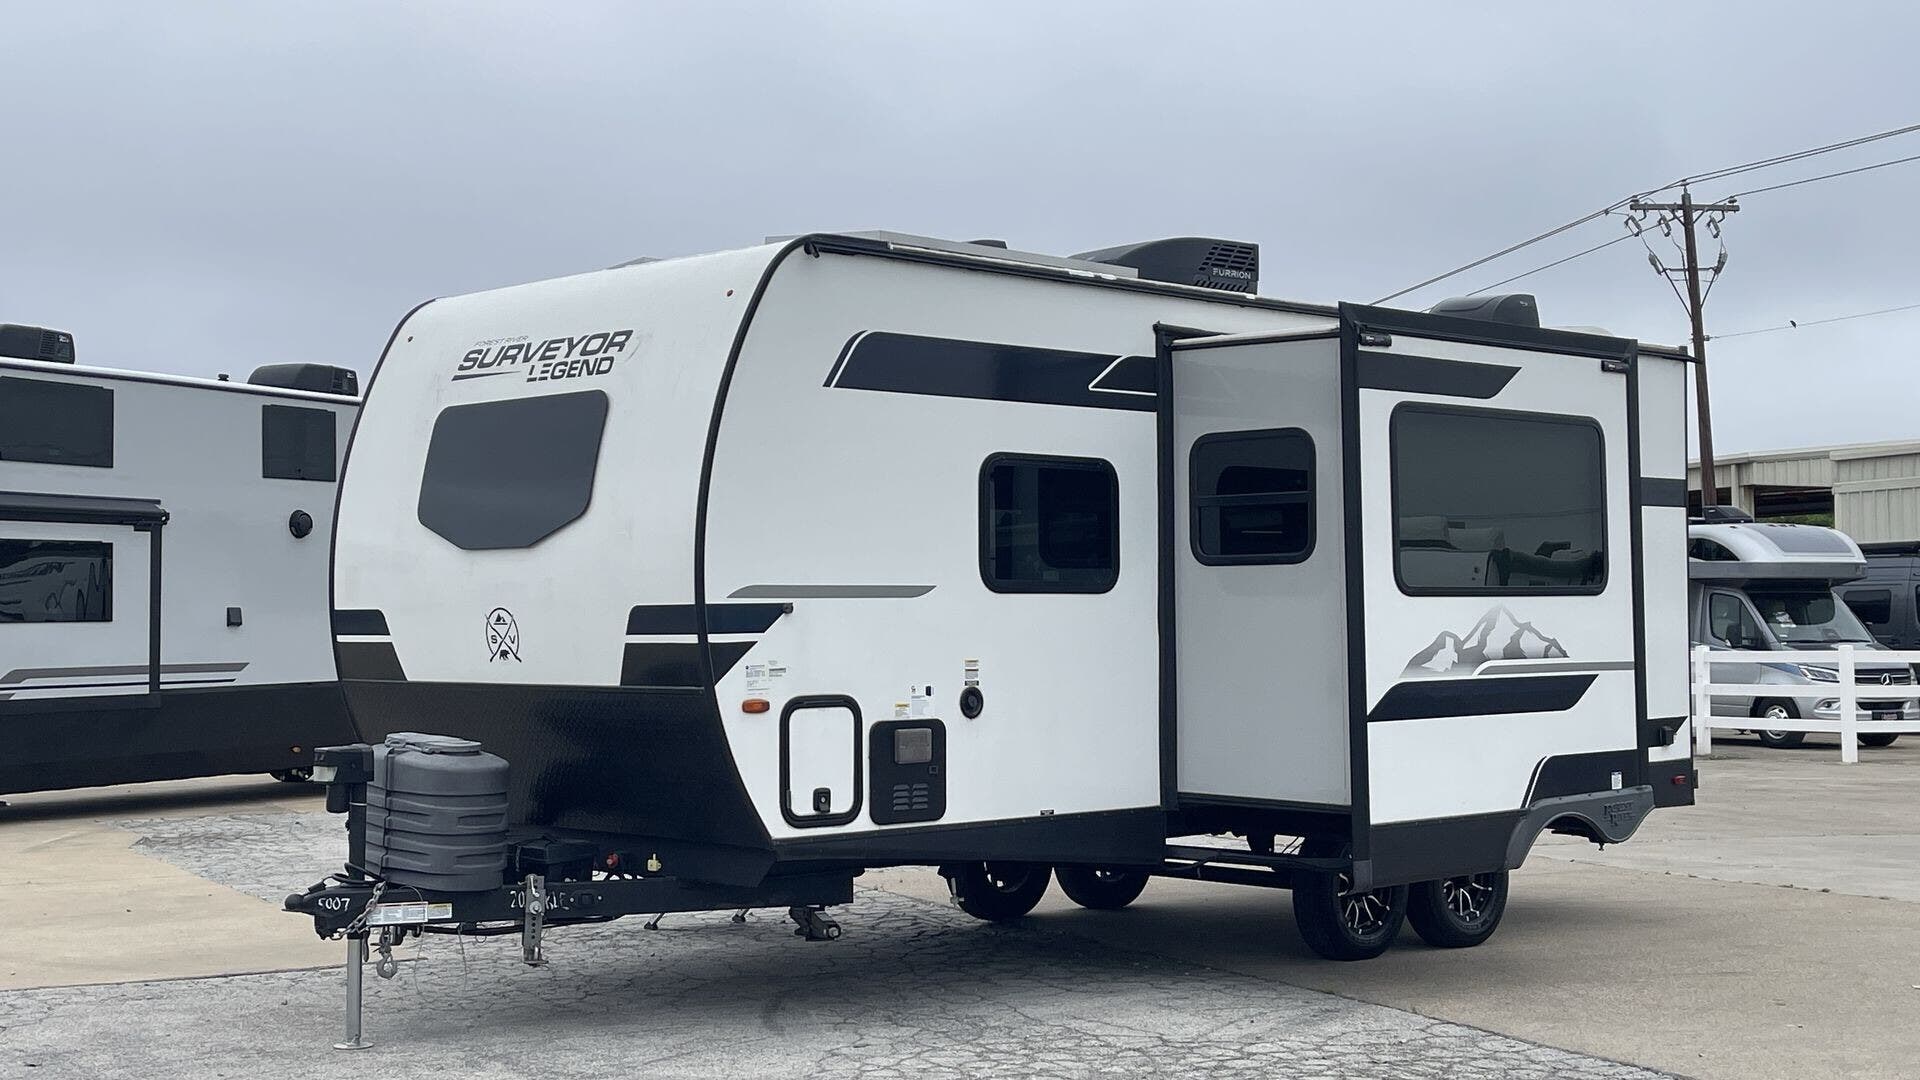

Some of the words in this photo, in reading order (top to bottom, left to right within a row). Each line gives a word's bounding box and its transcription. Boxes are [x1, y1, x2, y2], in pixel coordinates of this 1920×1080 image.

[1212, 267, 1252, 279] FURRION
[457, 329, 634, 372] SURVEYOR
[526, 356, 615, 383] LEGEND
[491, 635, 498, 644] S
[508, 635, 516, 644] V
